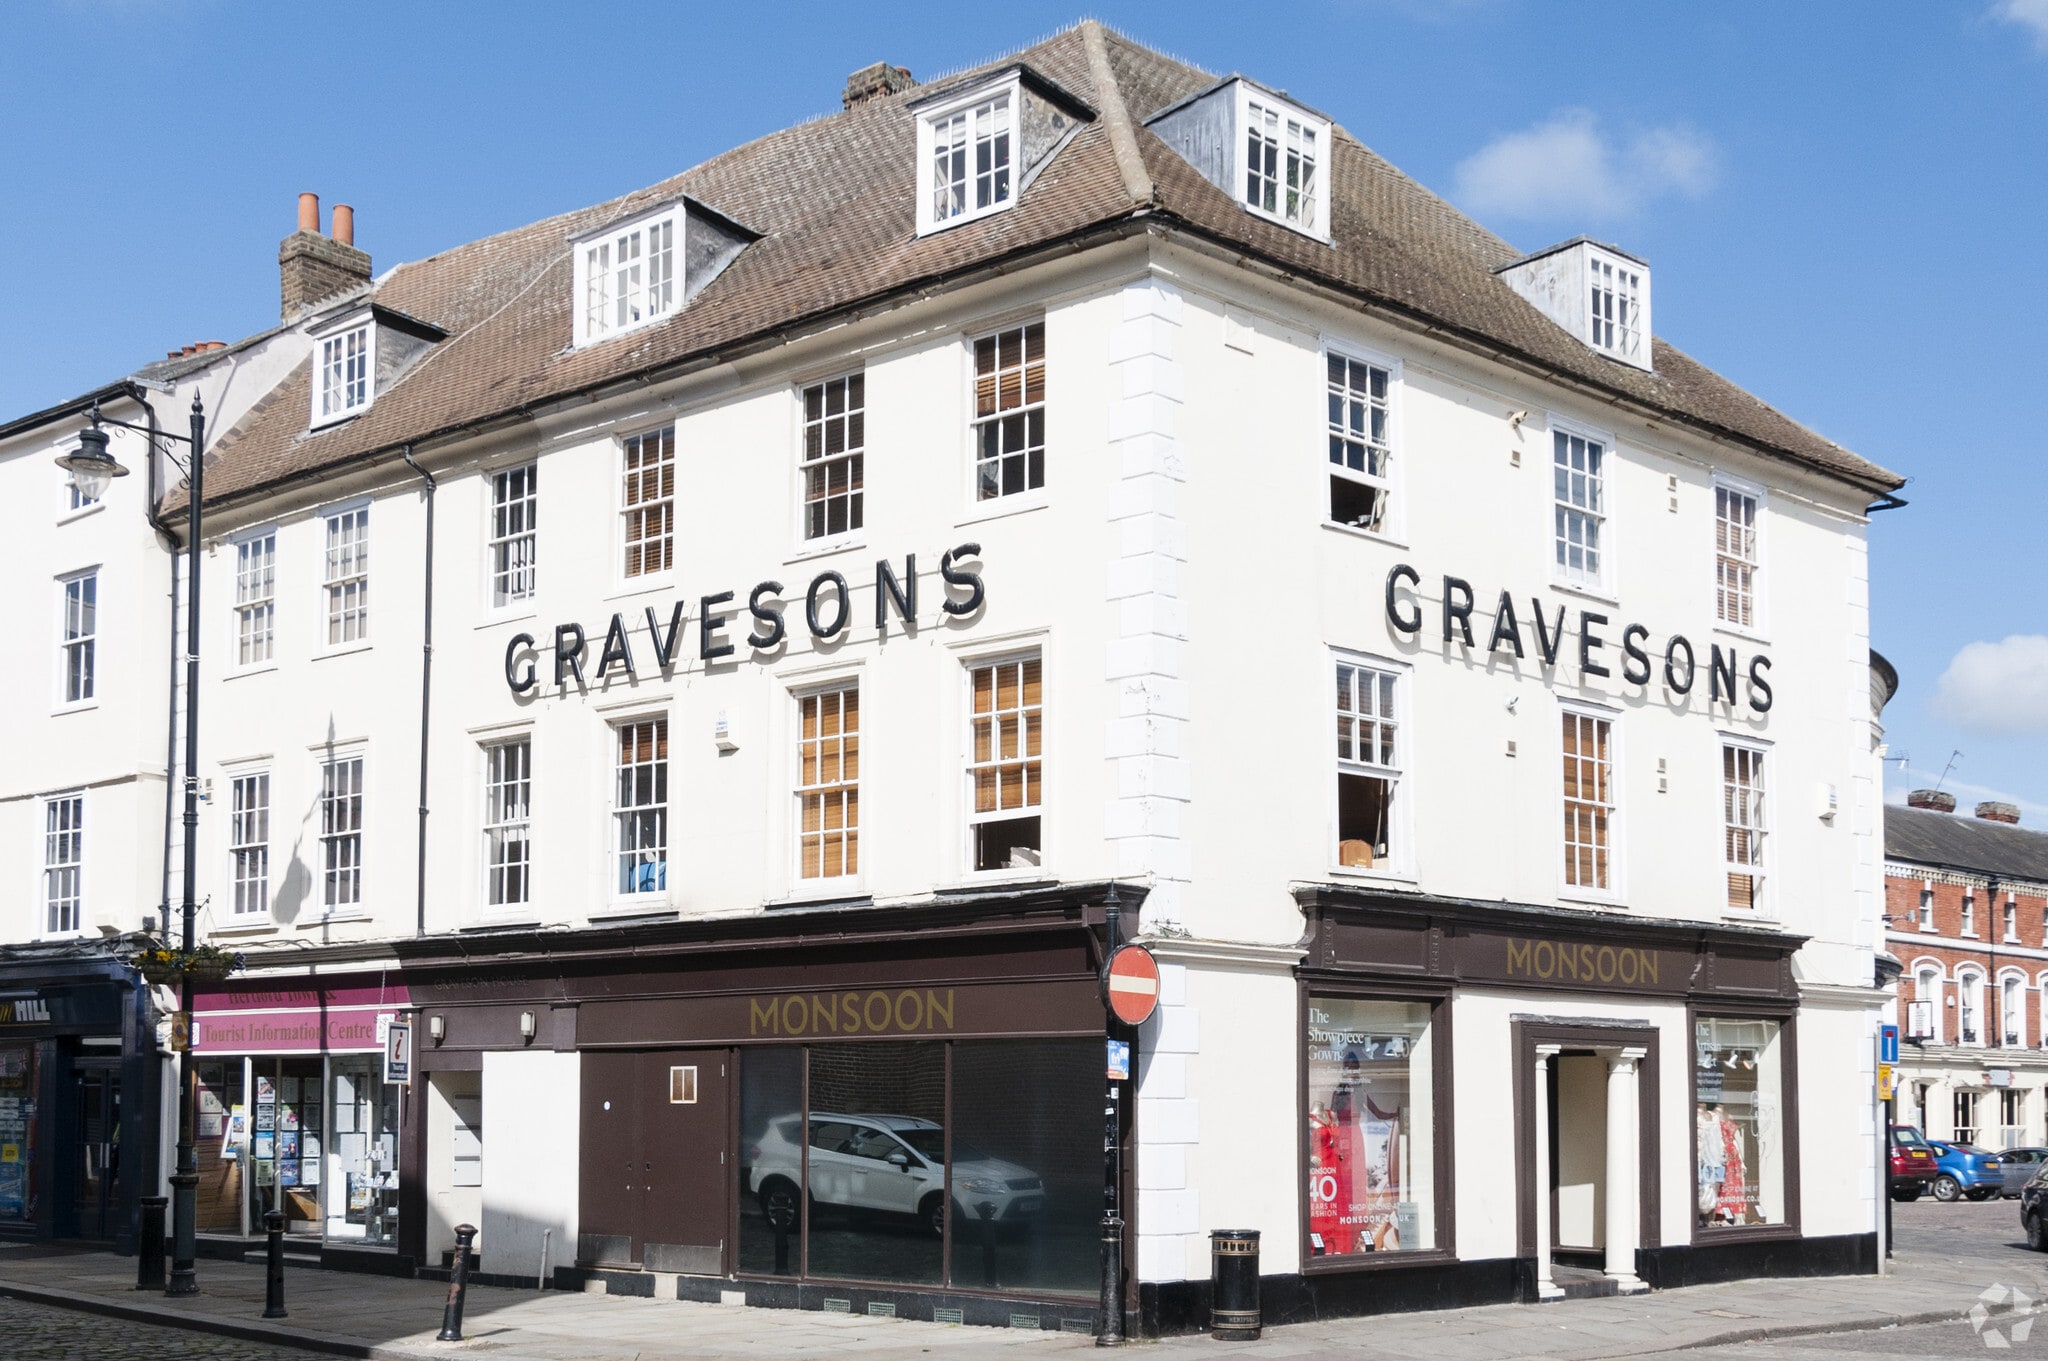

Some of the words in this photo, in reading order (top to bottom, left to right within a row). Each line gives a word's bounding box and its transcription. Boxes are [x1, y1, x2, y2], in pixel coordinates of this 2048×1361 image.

[505, 542, 985, 692] GRAVESONS
[1385, 563, 1773, 713] GRAVESONS
[1506, 938, 1659, 984] MONSOON
[14, 998, 51, 1022] HILL
[750, 989, 954, 1035] MONSOON
[1308, 1007, 1330, 1024] The
[204, 1023, 245, 1042] Tourist
[249, 1021, 321, 1041] Information
[328, 1020, 373, 1039] Centre
[1308, 1027, 1364, 1045] Showpiece
[1310, 1167, 1337, 1175] ONSOON
[1310, 1175, 1338, 1202] 40
[1310, 1210, 1338, 1218] ASHION
[1219, 1241, 1258, 1251] LITTE
